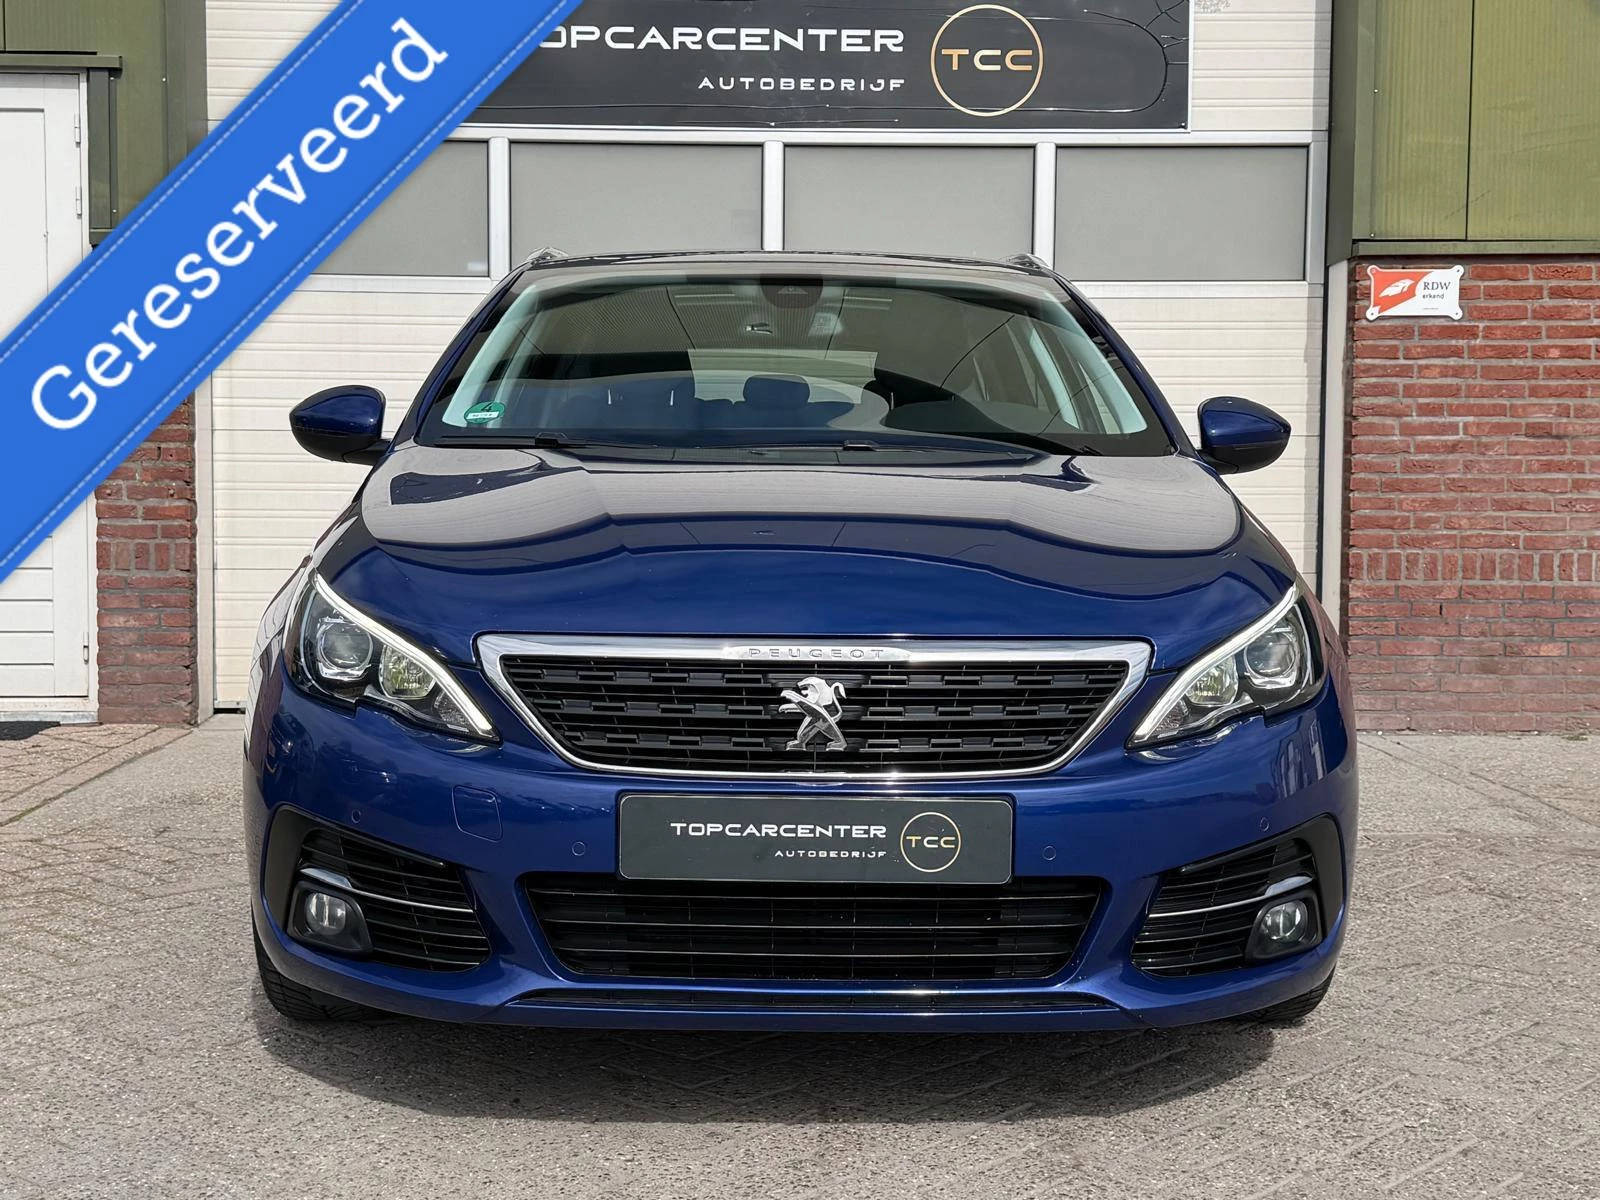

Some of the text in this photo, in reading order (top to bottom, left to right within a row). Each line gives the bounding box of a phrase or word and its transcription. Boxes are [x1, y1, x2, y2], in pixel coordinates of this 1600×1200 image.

[538, 25, 904, 53] OPCARCENTER
[942, 48, 1033, 72] TCC
[698, 76, 905, 92] AUTOBEDRIJF
[1422, 281, 1451, 291] RDW
[749, 648, 884, 658] PEUGEOT
[670, 822, 887, 838] TOPCARCENTER
[905, 835, 956, 848] TCC
[774, 850, 887, 858] AUTOBEDRIJF
